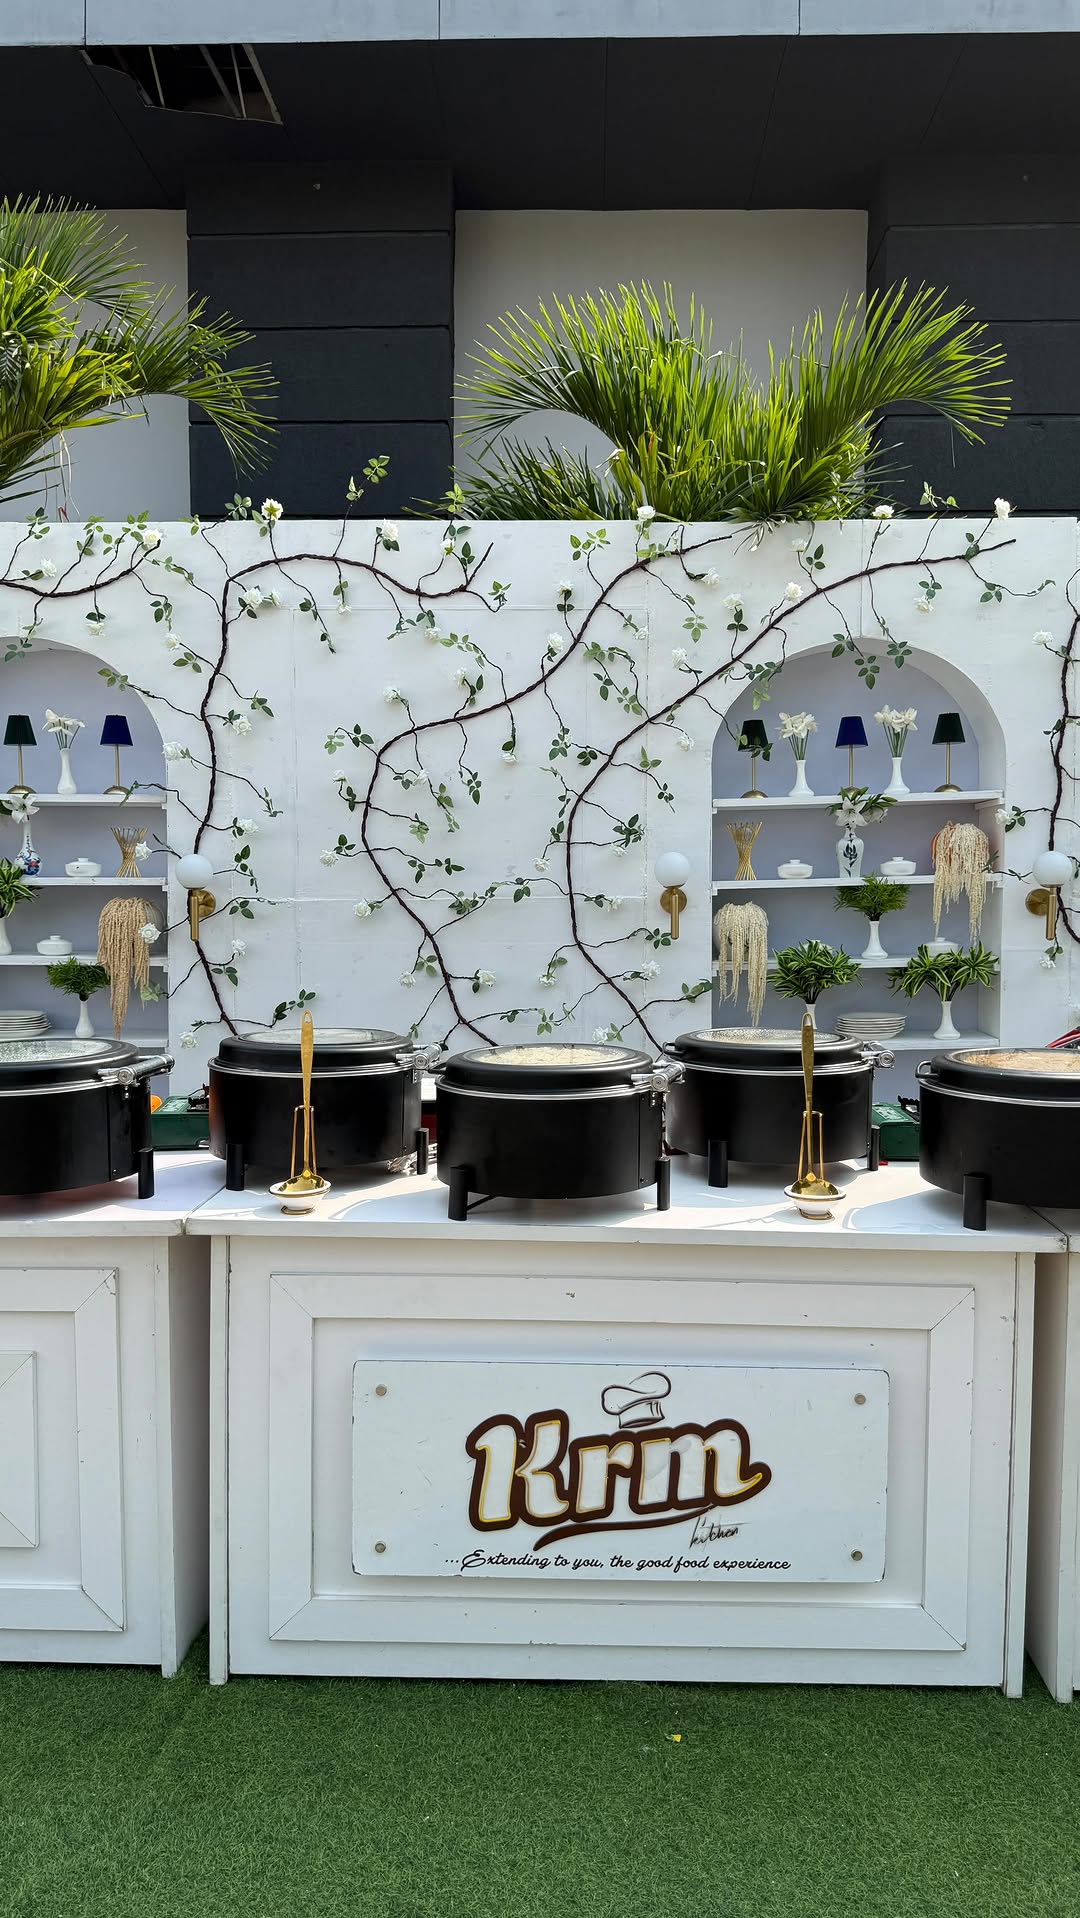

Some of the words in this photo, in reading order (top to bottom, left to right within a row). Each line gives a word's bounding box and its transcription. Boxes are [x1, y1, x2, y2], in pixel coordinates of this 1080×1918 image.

[466, 1409, 772, 1531] Krm
[554, 1554, 571, 1566] to
[572, 1559, 604, 1570] you,
[609, 1555, 634, 1568] the
[636, 1556, 673, 1571] good
[672, 1555, 709, 1573] food
[713, 1557, 791, 1571] experience
